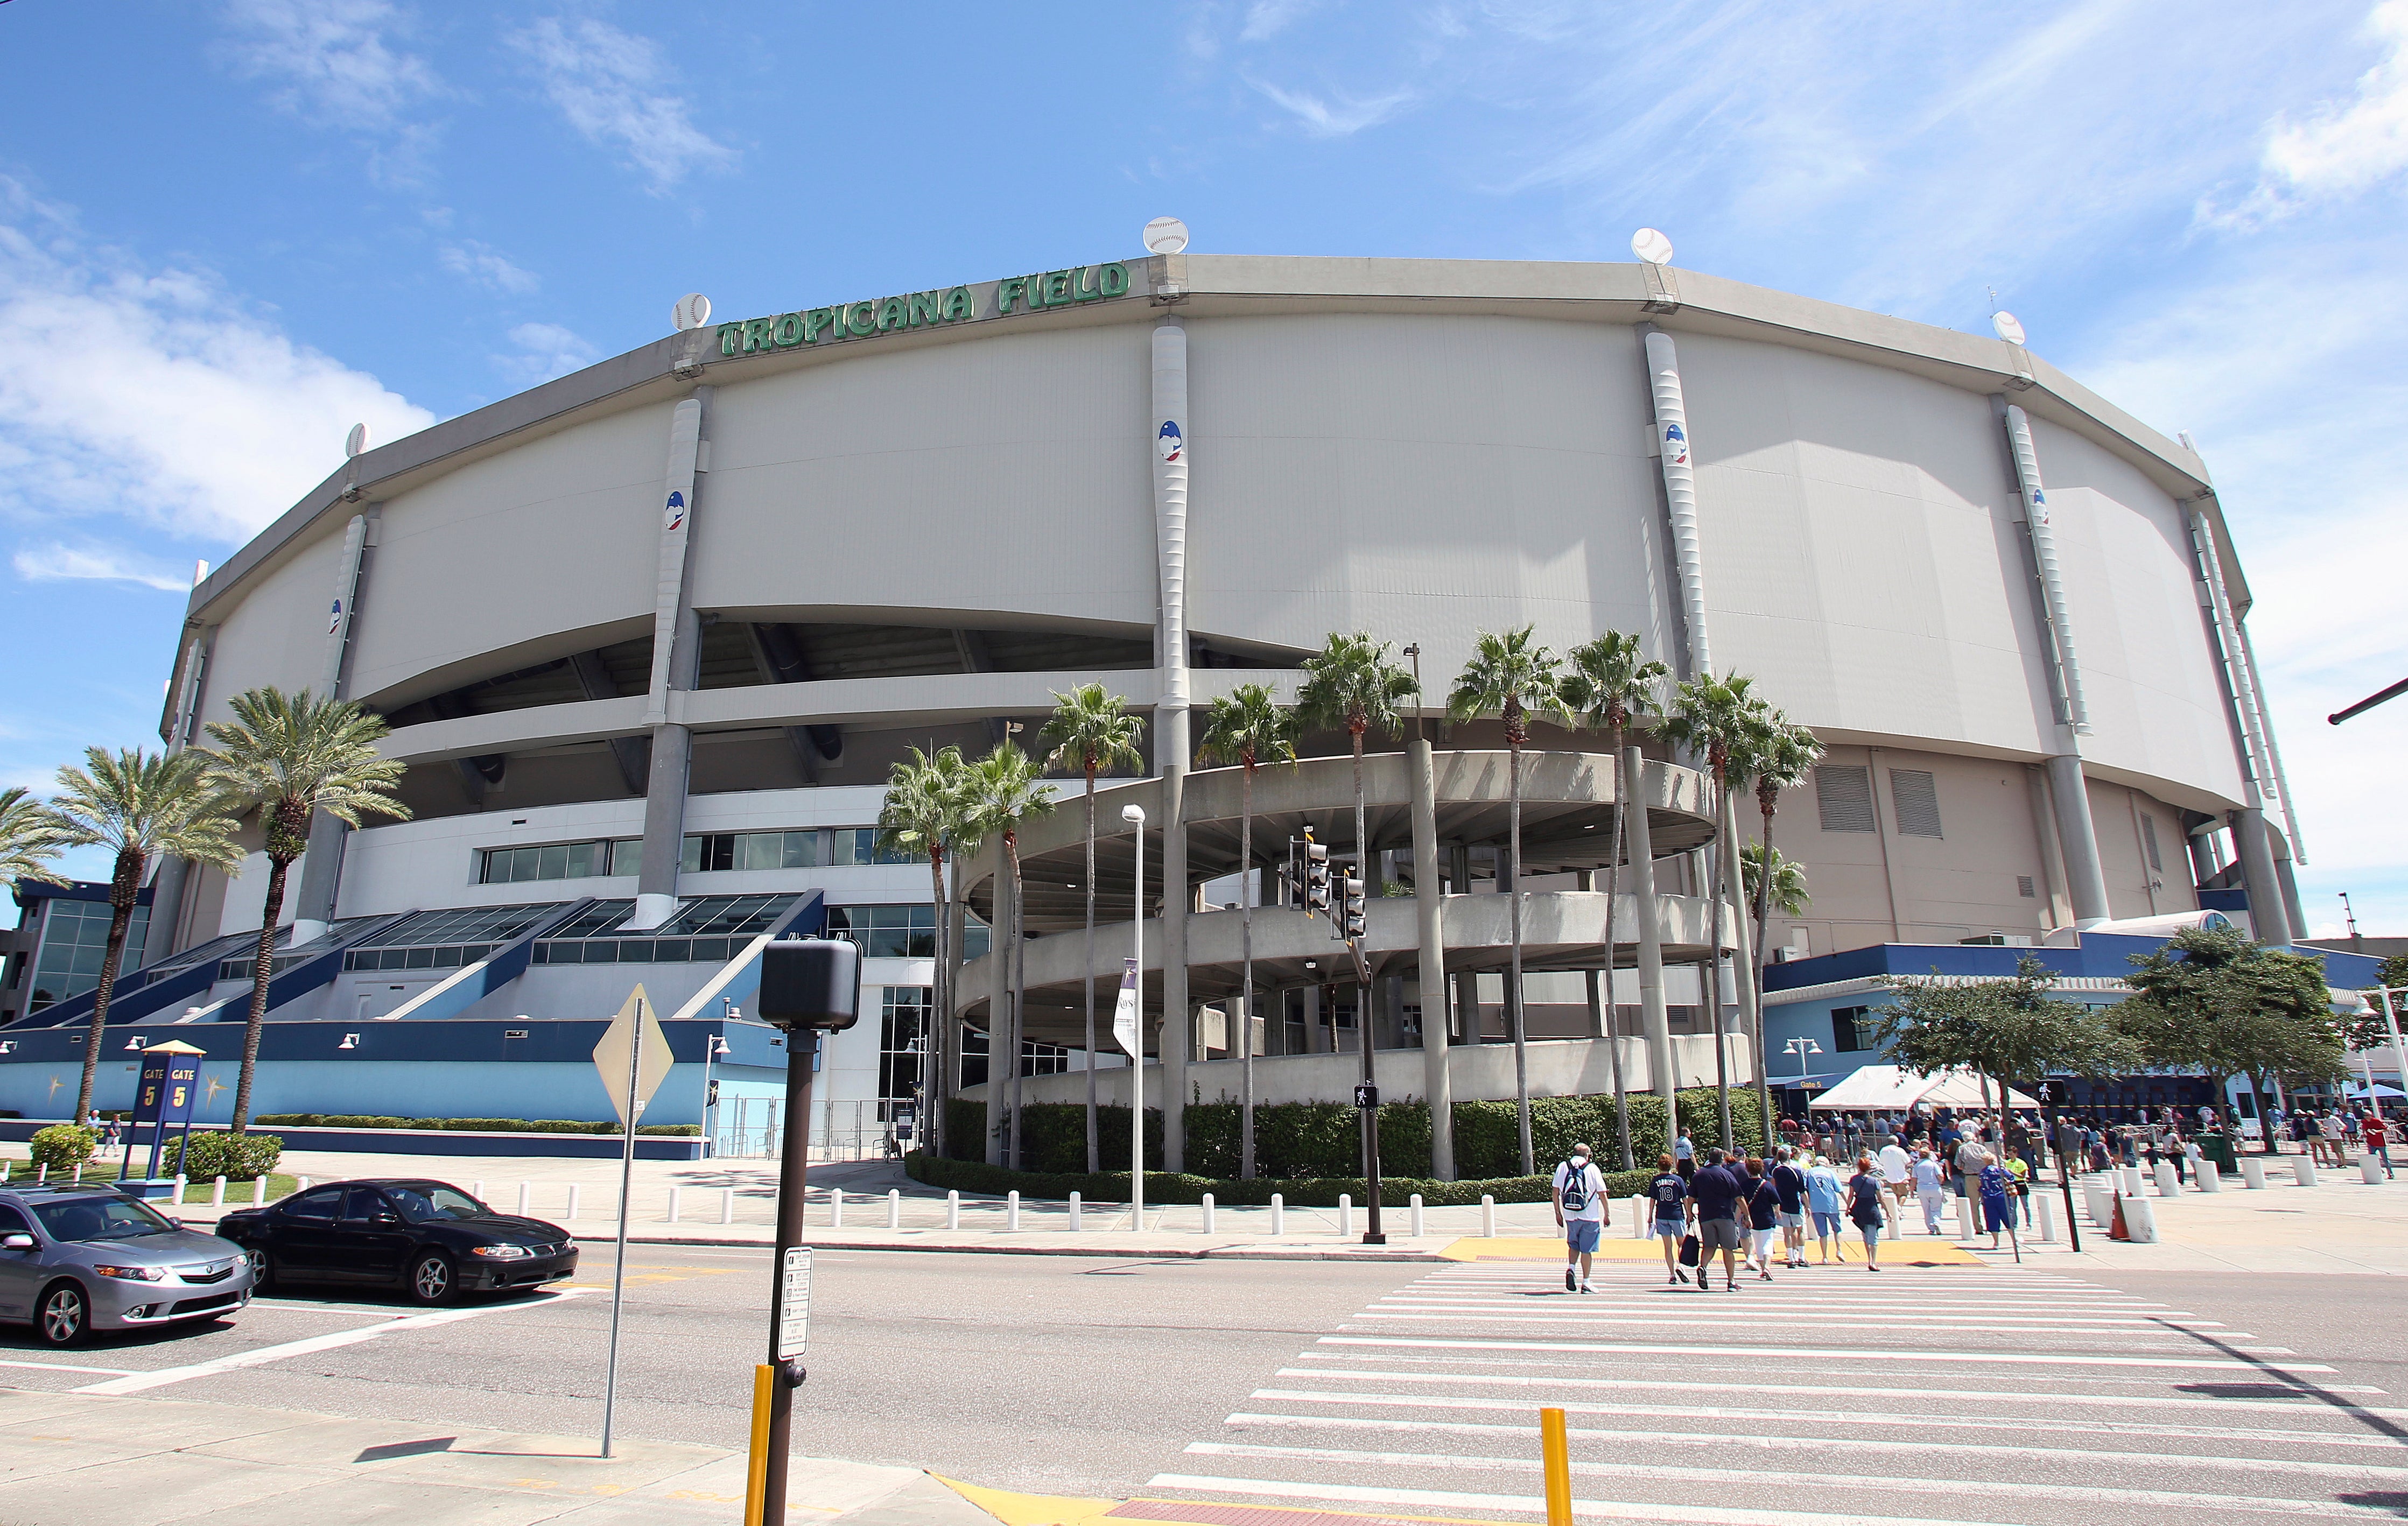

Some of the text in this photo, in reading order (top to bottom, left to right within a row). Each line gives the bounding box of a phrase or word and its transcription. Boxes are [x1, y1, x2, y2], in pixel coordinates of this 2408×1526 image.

[716, 262, 1130, 356] TROPICANA FIELD
[144, 1069, 164, 1079] GATE
[172, 1069, 194, 1080] GATE
[144, 1086, 156, 1106] 5
[173, 1087, 186, 1107] 5
[1816, 1176, 1823, 1188] 3
[1659, 1187, 1673, 1201] 18
